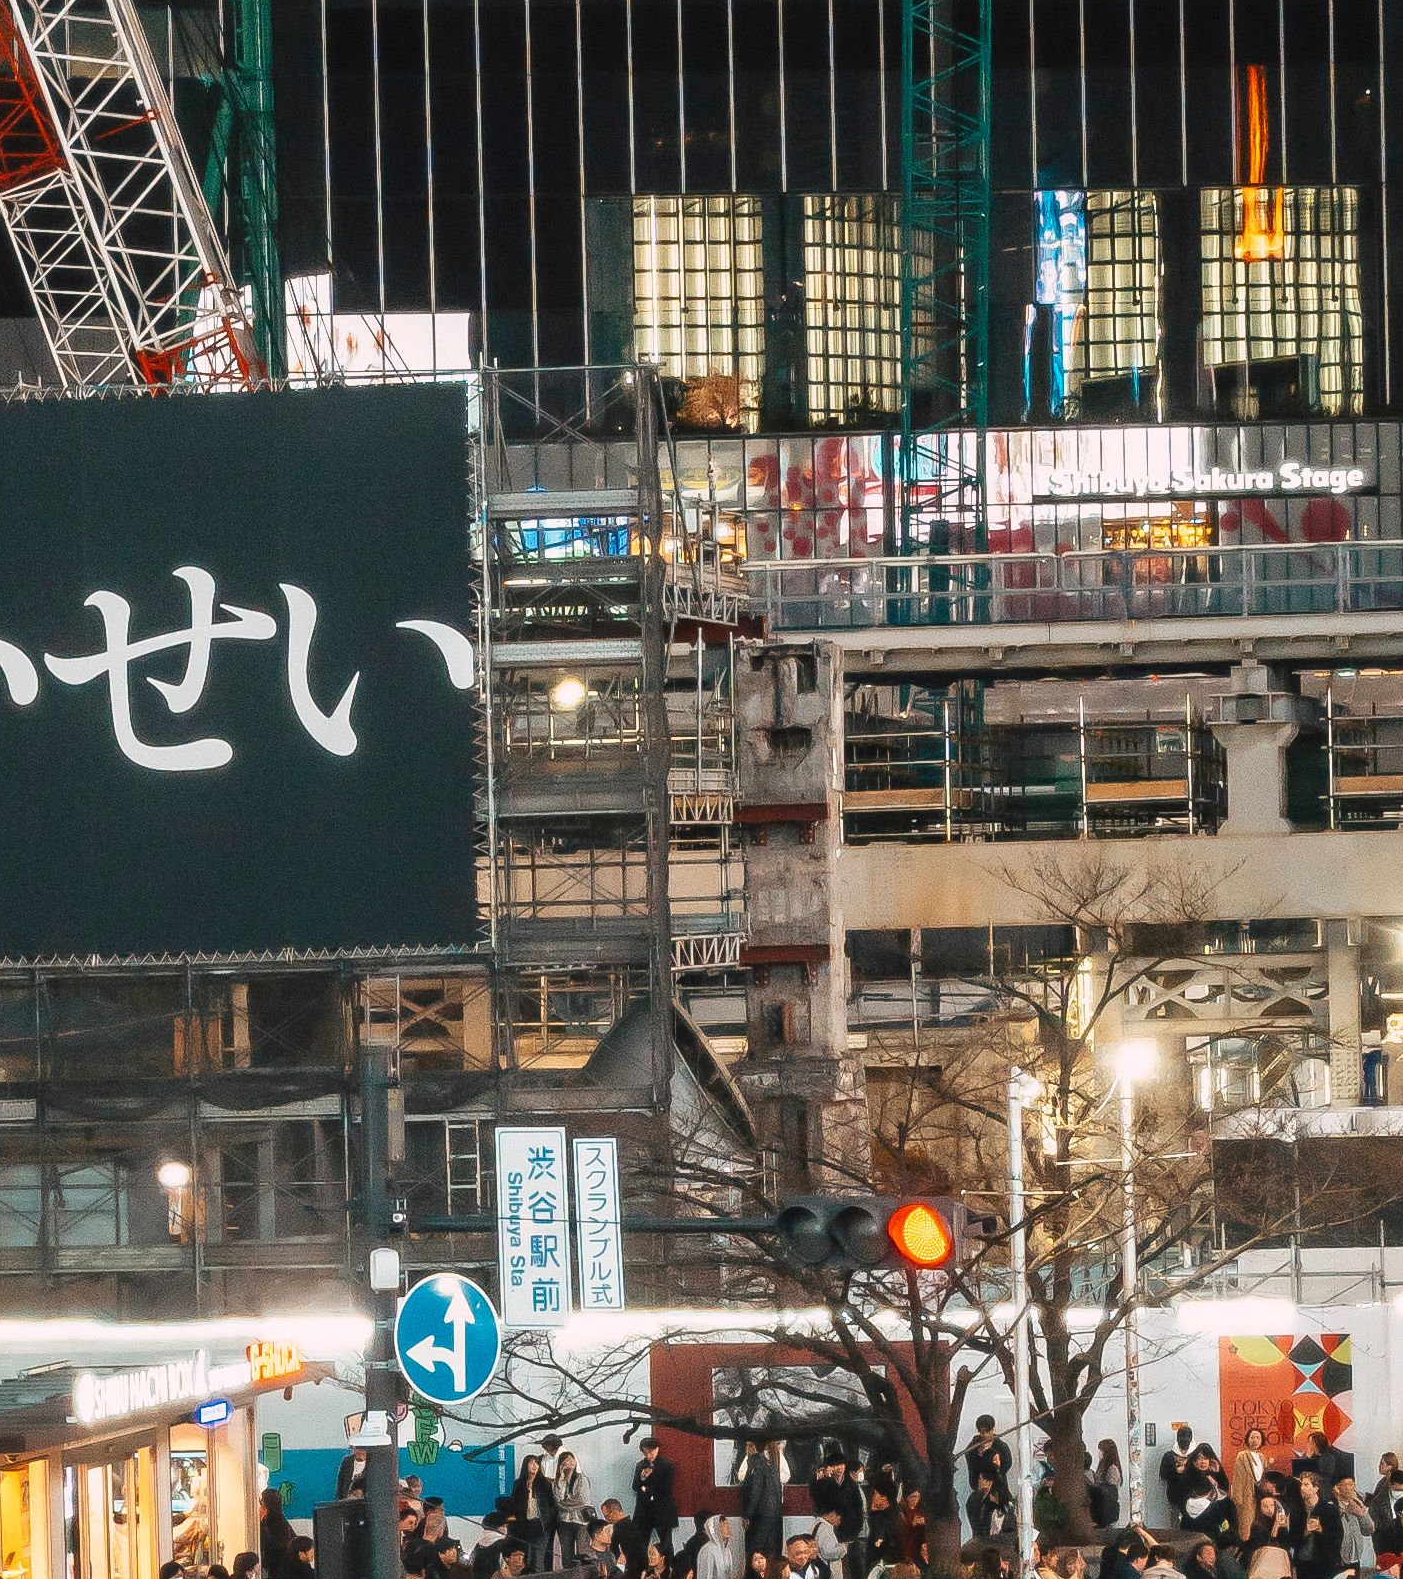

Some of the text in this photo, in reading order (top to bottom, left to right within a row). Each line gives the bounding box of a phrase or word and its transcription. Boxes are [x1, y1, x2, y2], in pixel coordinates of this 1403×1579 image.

[1049, 462, 1365, 497] Shibuya Sakura Stage
[507, 1171, 524, 1248] Shibuya
[527, 1146, 561, 1312] 渋谷駅前
[584, 1147, 614, 1306] スクランブル式
[1232, 1400, 1293, 1415] TOKYO
